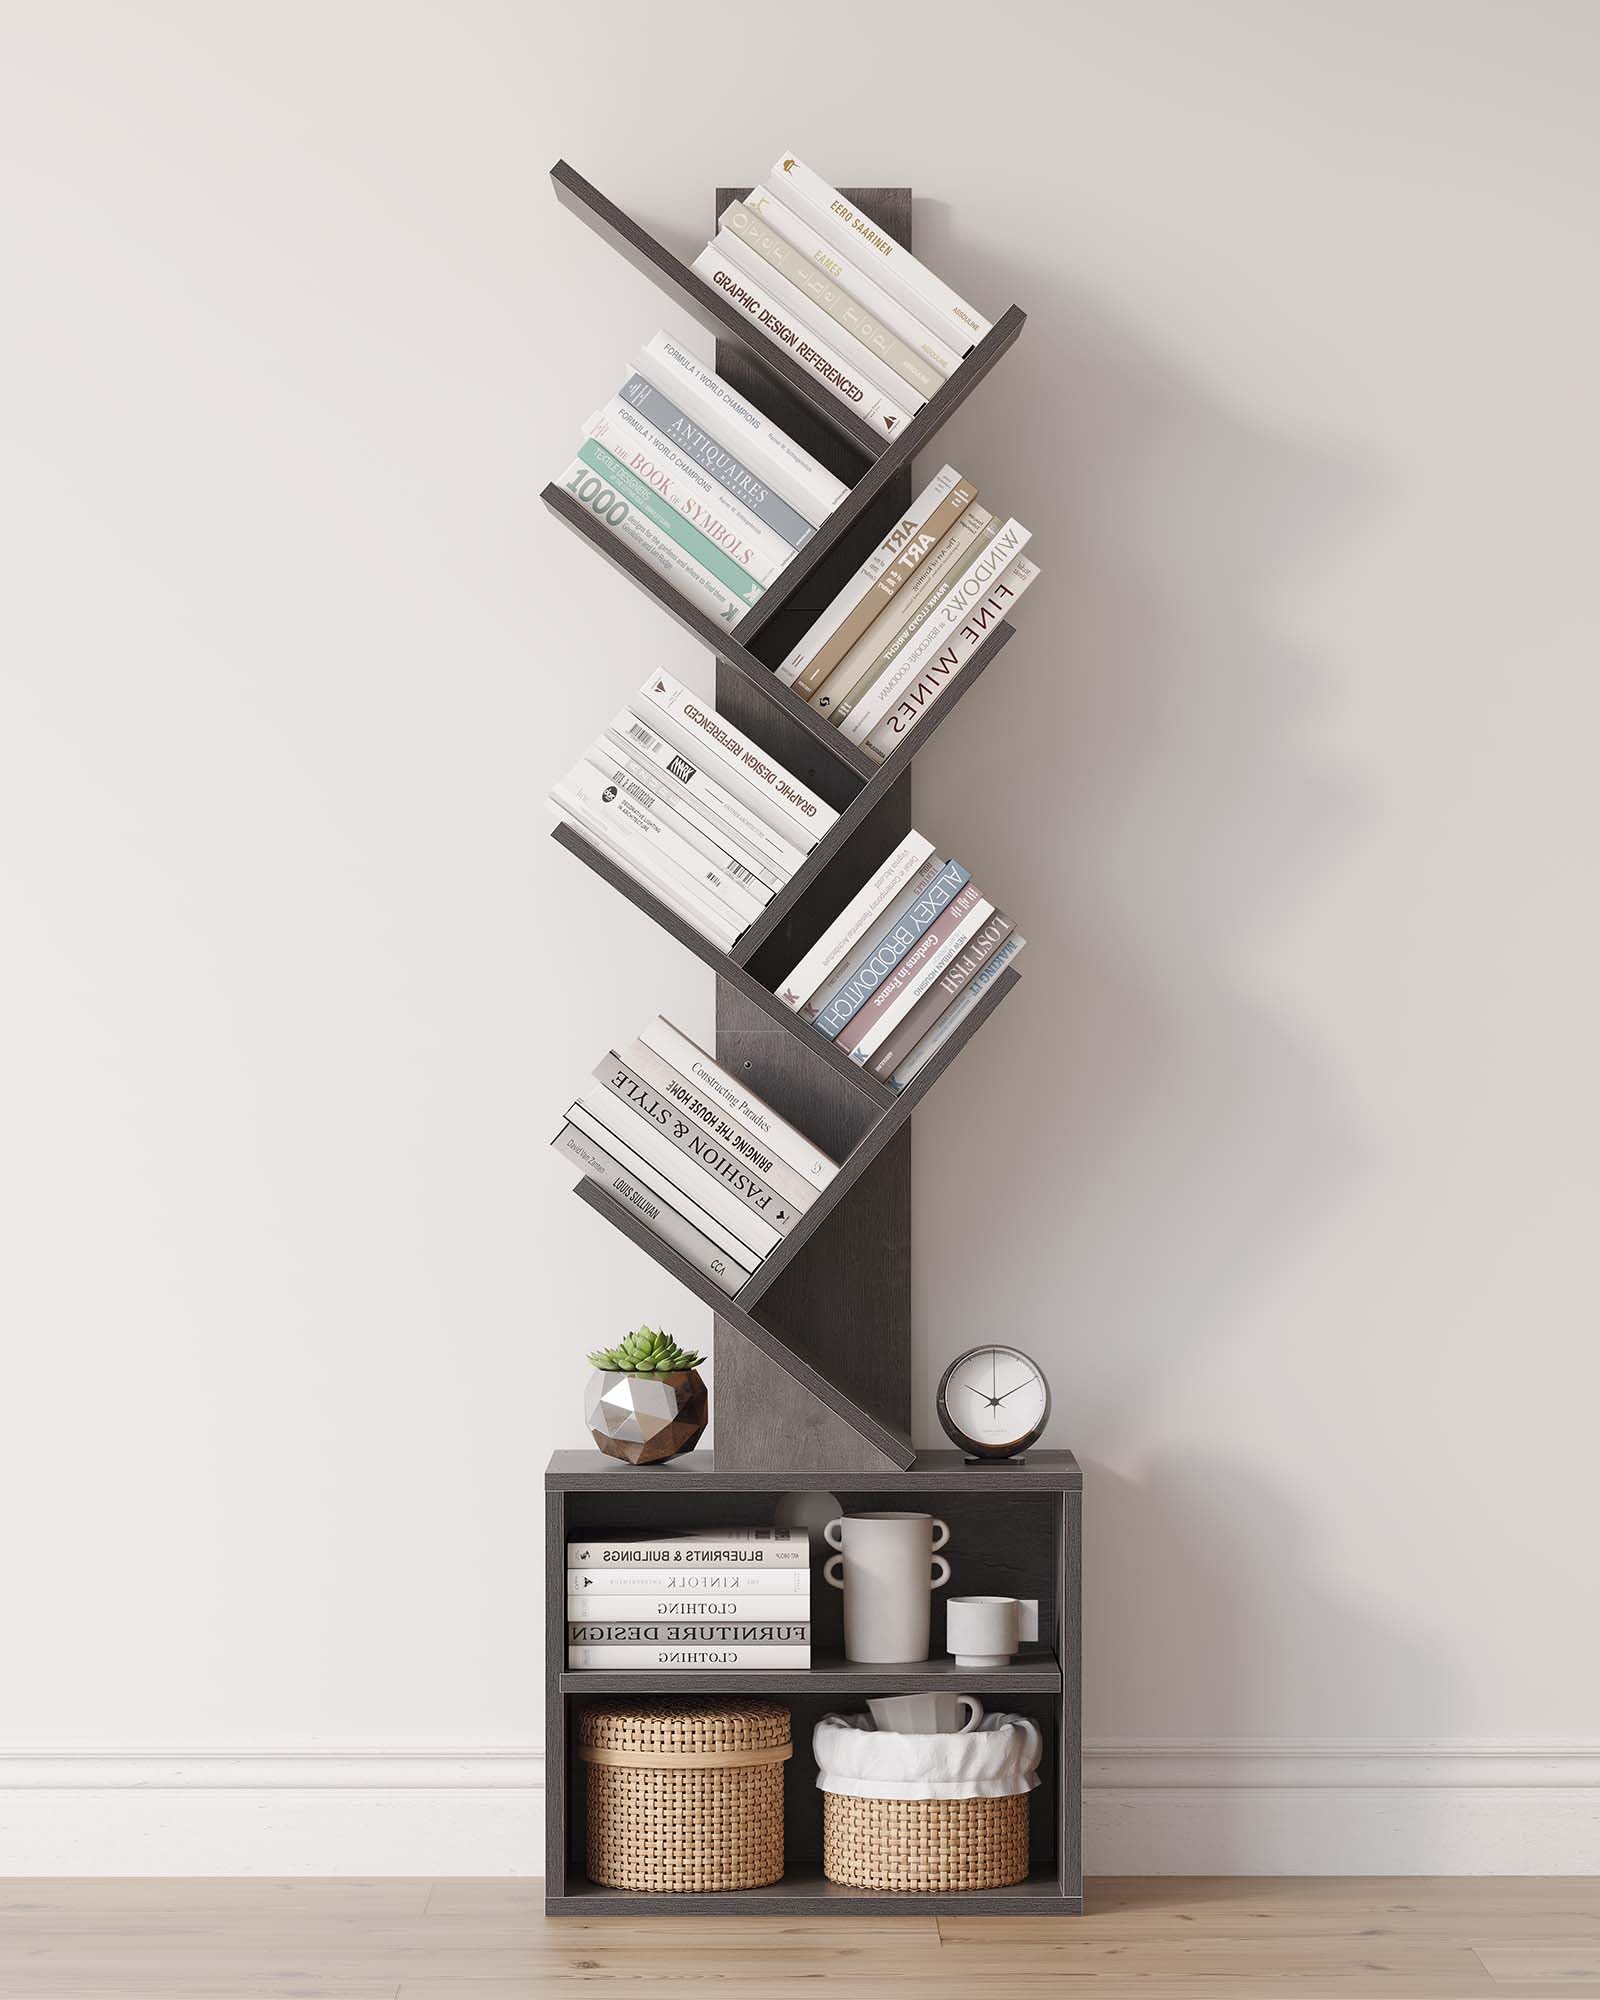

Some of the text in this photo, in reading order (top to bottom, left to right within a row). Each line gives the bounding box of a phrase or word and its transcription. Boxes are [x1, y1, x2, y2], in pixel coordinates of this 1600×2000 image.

[829, 200, 892, 255] EERO SAARINEN
[812, 250, 842, 277] EAMES
[712, 271, 863, 401] GRAPHIC DESIGN REFERENCED
[663, 343, 760, 429] FORMULA 1 WORLD CHAMPIONS
[593, 447, 652, 500] TEXTILE DESIGNERS
[617, 408, 648, 437] FORMULA
[652, 437, 676, 461] WORLD
[674, 458, 712, 492] CHAMPIONS
[672, 418, 768, 502] ANTIQUAIRES
[566, 469, 628, 528] 1000
[613, 445, 629, 460] THE
[629, 453, 673, 495] BOOK
[669, 493, 680, 504] OF
[680, 499, 753, 564] SYMBOLS
[683, 704, 743, 755] REFERENCED
[740, 751, 777, 784] DESIGN
[775, 780, 816, 816] GRAPHIC
[909, 865, 961, 931] ALEXEY
[935, 948, 955, 970] URBAN
[952, 934, 967, 950] NEW
[970, 916, 1009, 960] LOST
[824, 926, 914, 1027] BRODOVITCH
[873, 934, 938, 1006] Gardens in France
[912, 968, 938, 996] HOUSING
[939, 955, 976, 995] FISH
[966, 940, 1016, 997] MAKING IT
[665, 1079, 773, 1172] BRINGING THE HOUSE HOME
[691, 1062, 771, 1132] Constructing Paradies
[611, 1070, 772, 1209] FASHION & STYLE
[612, 1177, 660, 1219] LOUIS SULLIVAN
